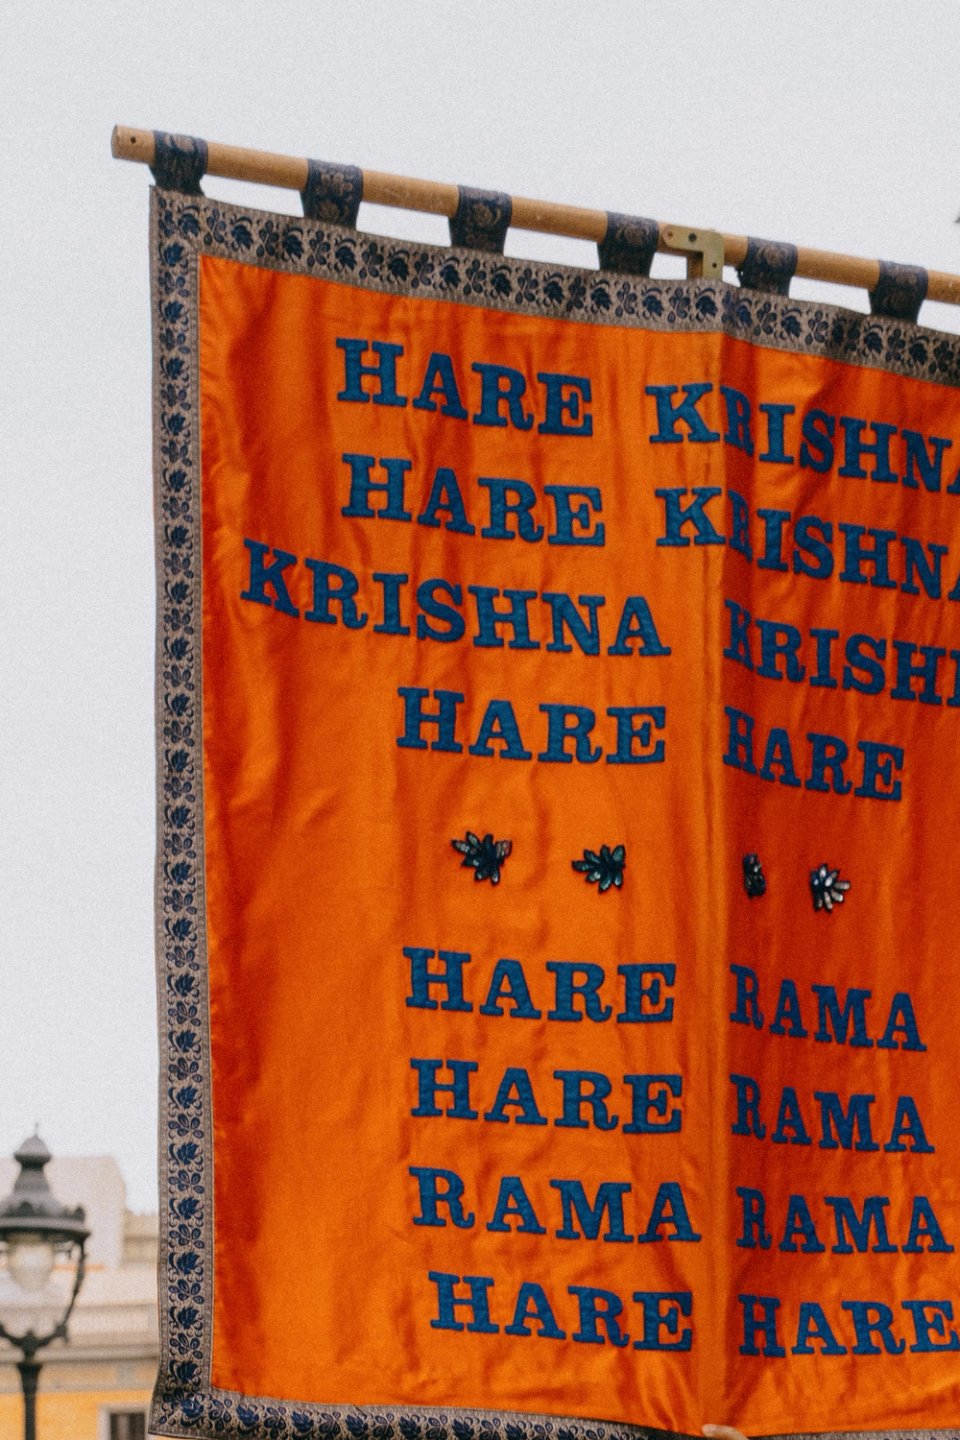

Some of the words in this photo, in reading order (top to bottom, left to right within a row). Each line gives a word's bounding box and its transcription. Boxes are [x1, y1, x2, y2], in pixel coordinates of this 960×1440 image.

[337, 338, 593, 436] HARE
[341, 453, 605, 546] HARE
[240, 537, 671, 656] KRISHNA
[396, 686, 666, 764] HARE
[723, 706, 904, 801] HARE
[403, 947, 676, 1023] HARE
[729, 964, 927, 1051] RAMA
[410, 1058, 682, 1134] HARE
[729, 1073, 935, 1153] RAMA
[409, 1166, 702, 1243] RAMA
[735, 1187, 954, 1254] RAMA
[428, 1271, 693, 1351] HARE
[738, 1294, 960, 1357] HARE
